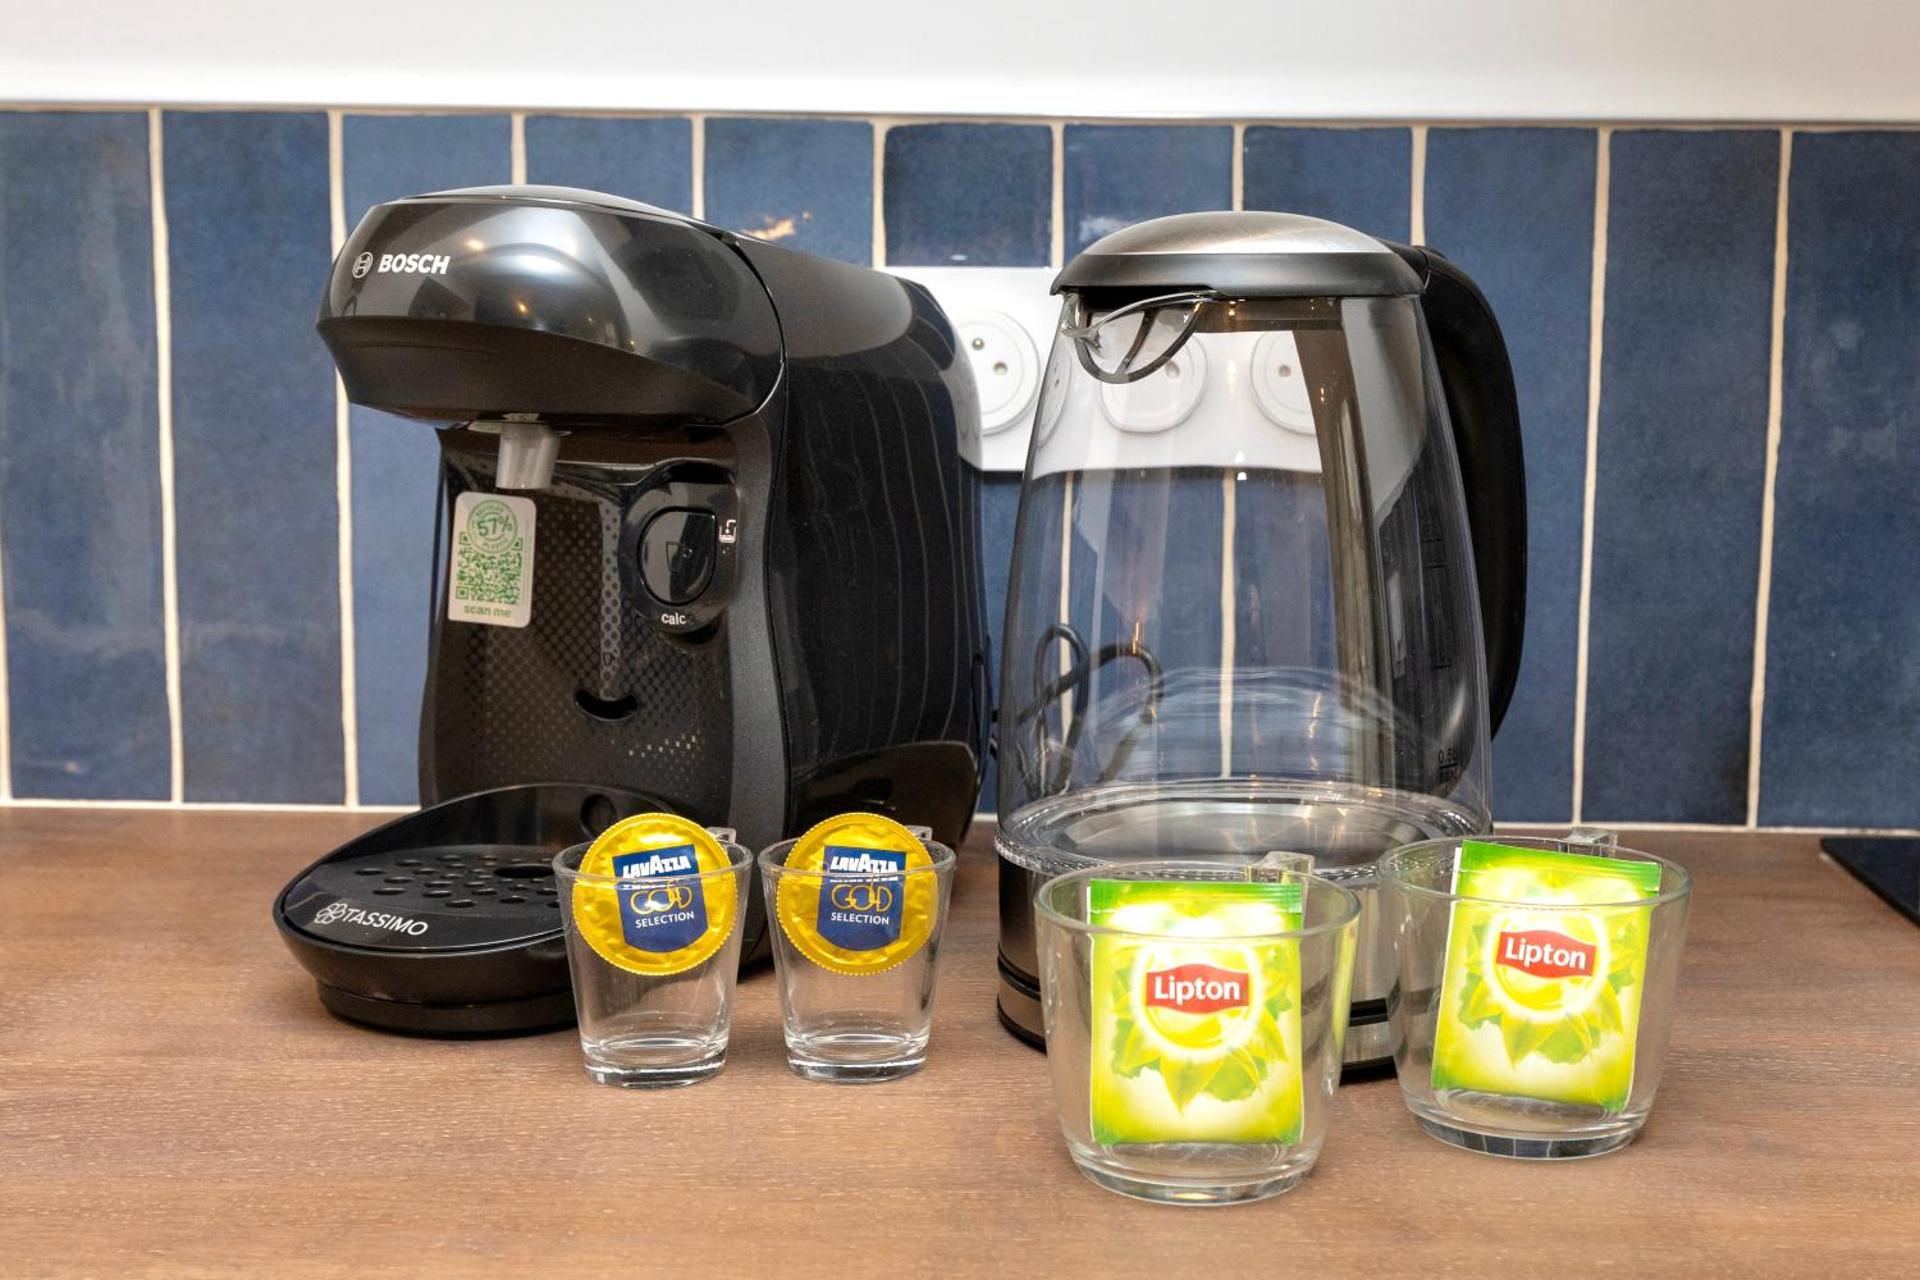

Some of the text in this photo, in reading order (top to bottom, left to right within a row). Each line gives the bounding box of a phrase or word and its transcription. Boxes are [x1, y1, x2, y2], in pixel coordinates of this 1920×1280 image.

[378, 253, 451, 275] BOSCH
[477, 515, 512, 537] 57%
[464, 605, 511, 618] scan me
[661, 612, 687, 625] calc
[622, 854, 692, 879] LAVAZZA
[830, 853, 899, 874] LAVAZZA
[831, 880, 893, 912] GOLD
[342, 908, 428, 935] TASSIMO
[635, 911, 695, 928] SELECTION
[830, 912, 890, 925] SELECTION
[1505, 938, 1586, 969] Lipton
[1154, 976, 1240, 1005] Lipton
